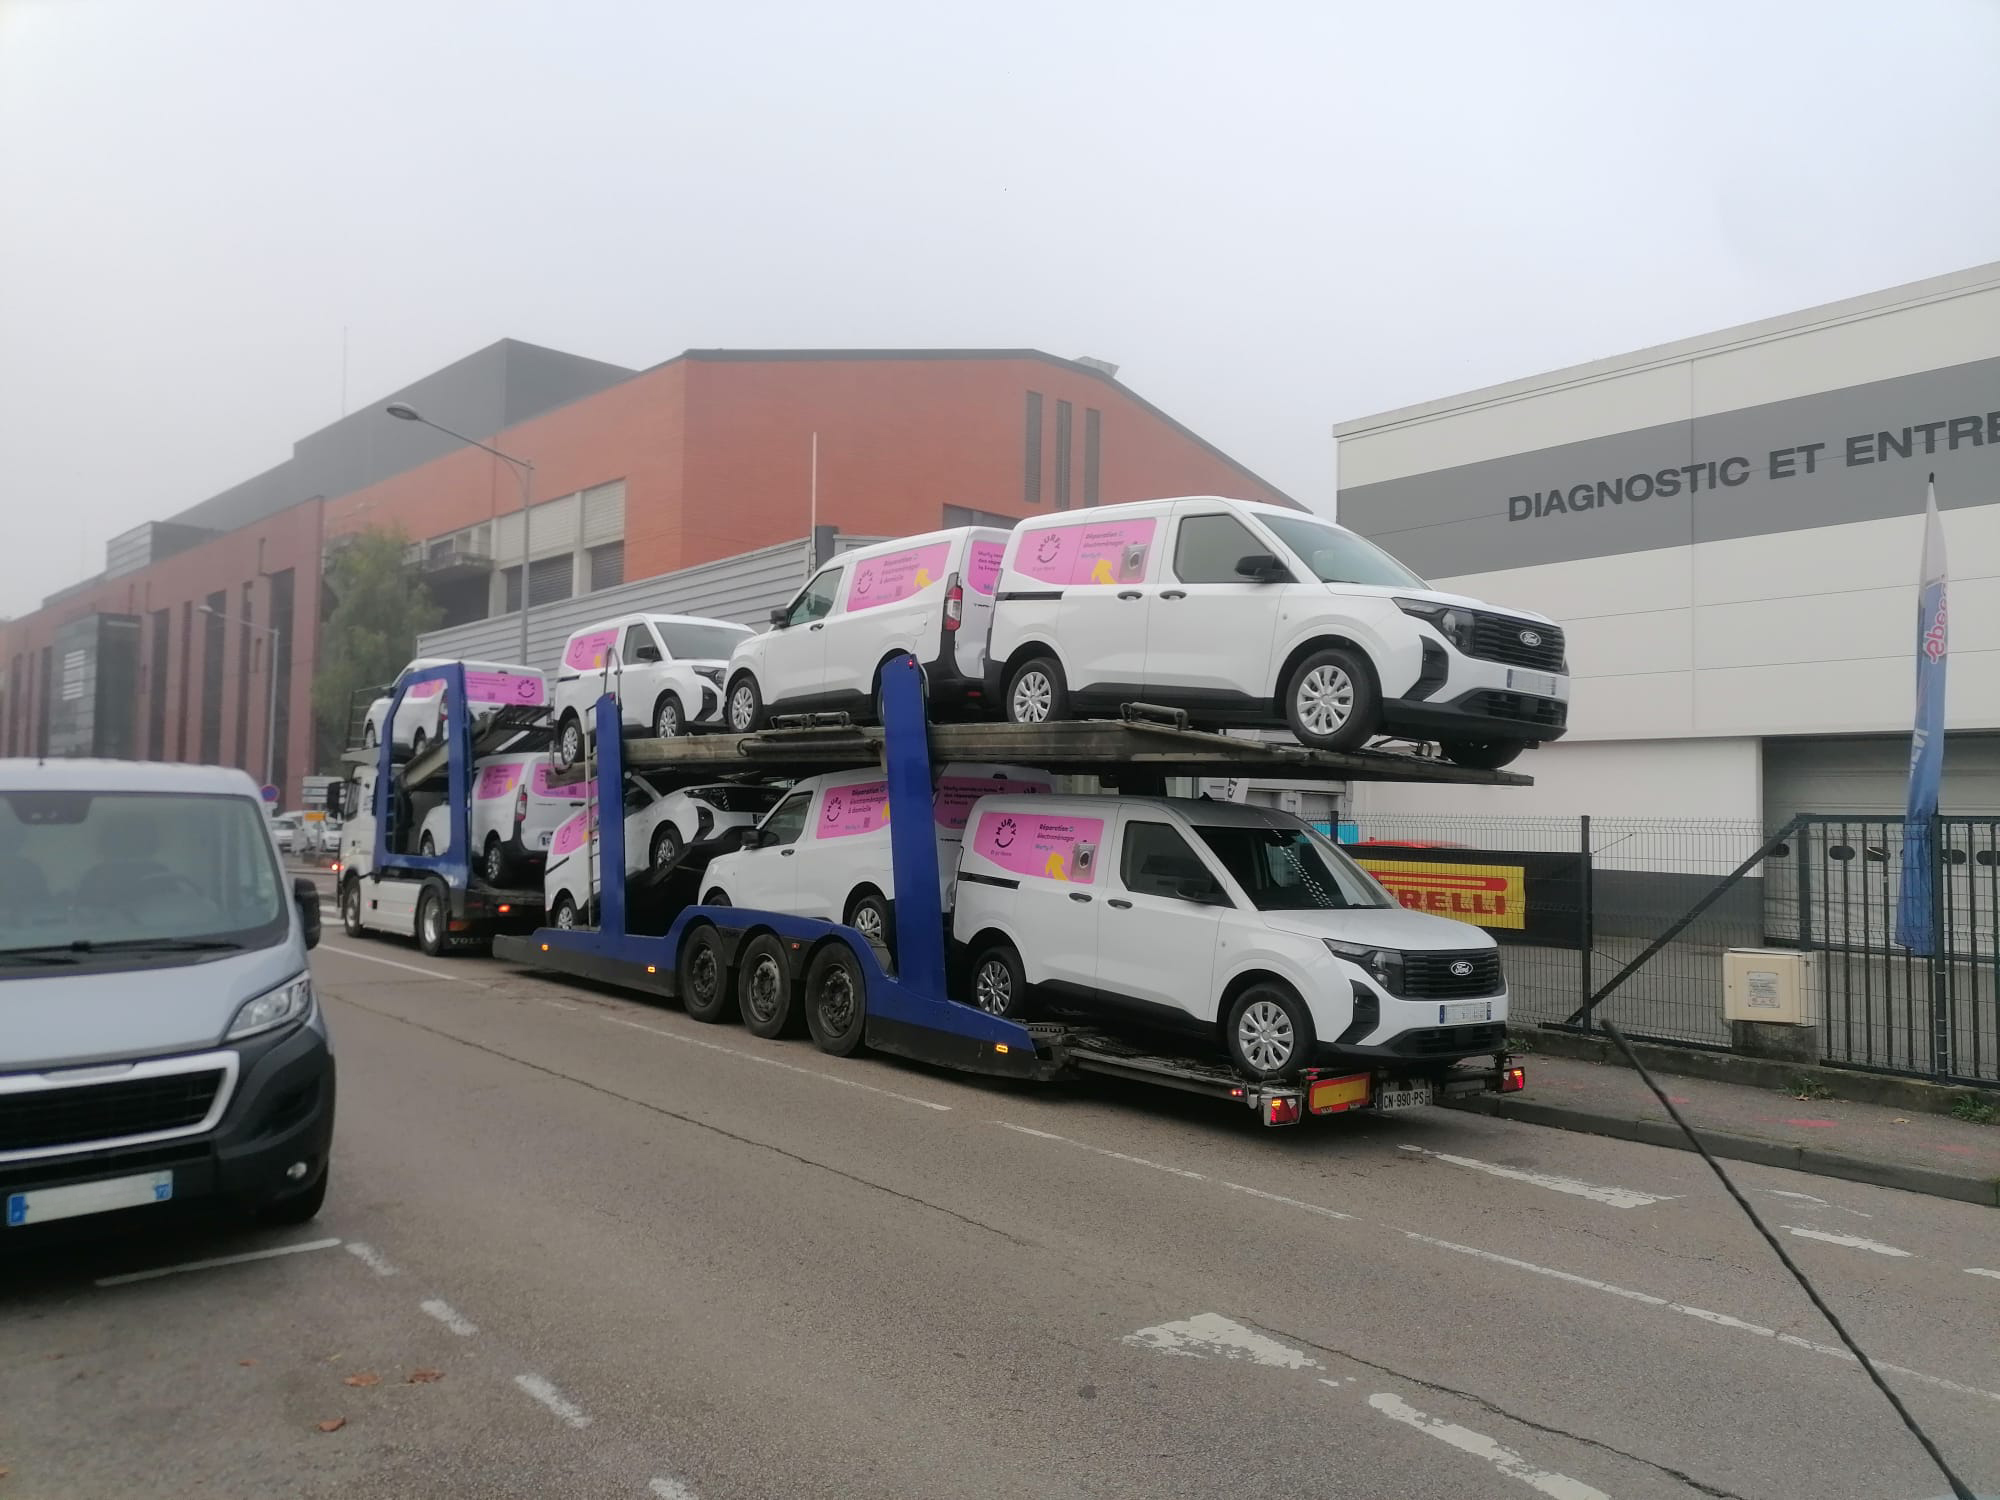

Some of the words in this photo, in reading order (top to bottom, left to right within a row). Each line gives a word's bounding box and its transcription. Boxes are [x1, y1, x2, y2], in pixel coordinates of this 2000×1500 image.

[1508, 456, 1750, 522] DIAGNOSTIC
[1768, 442, 1825, 480] ET
[995, 818, 1017, 836] MURFY
[1388, 888, 1506, 915] RELLI
